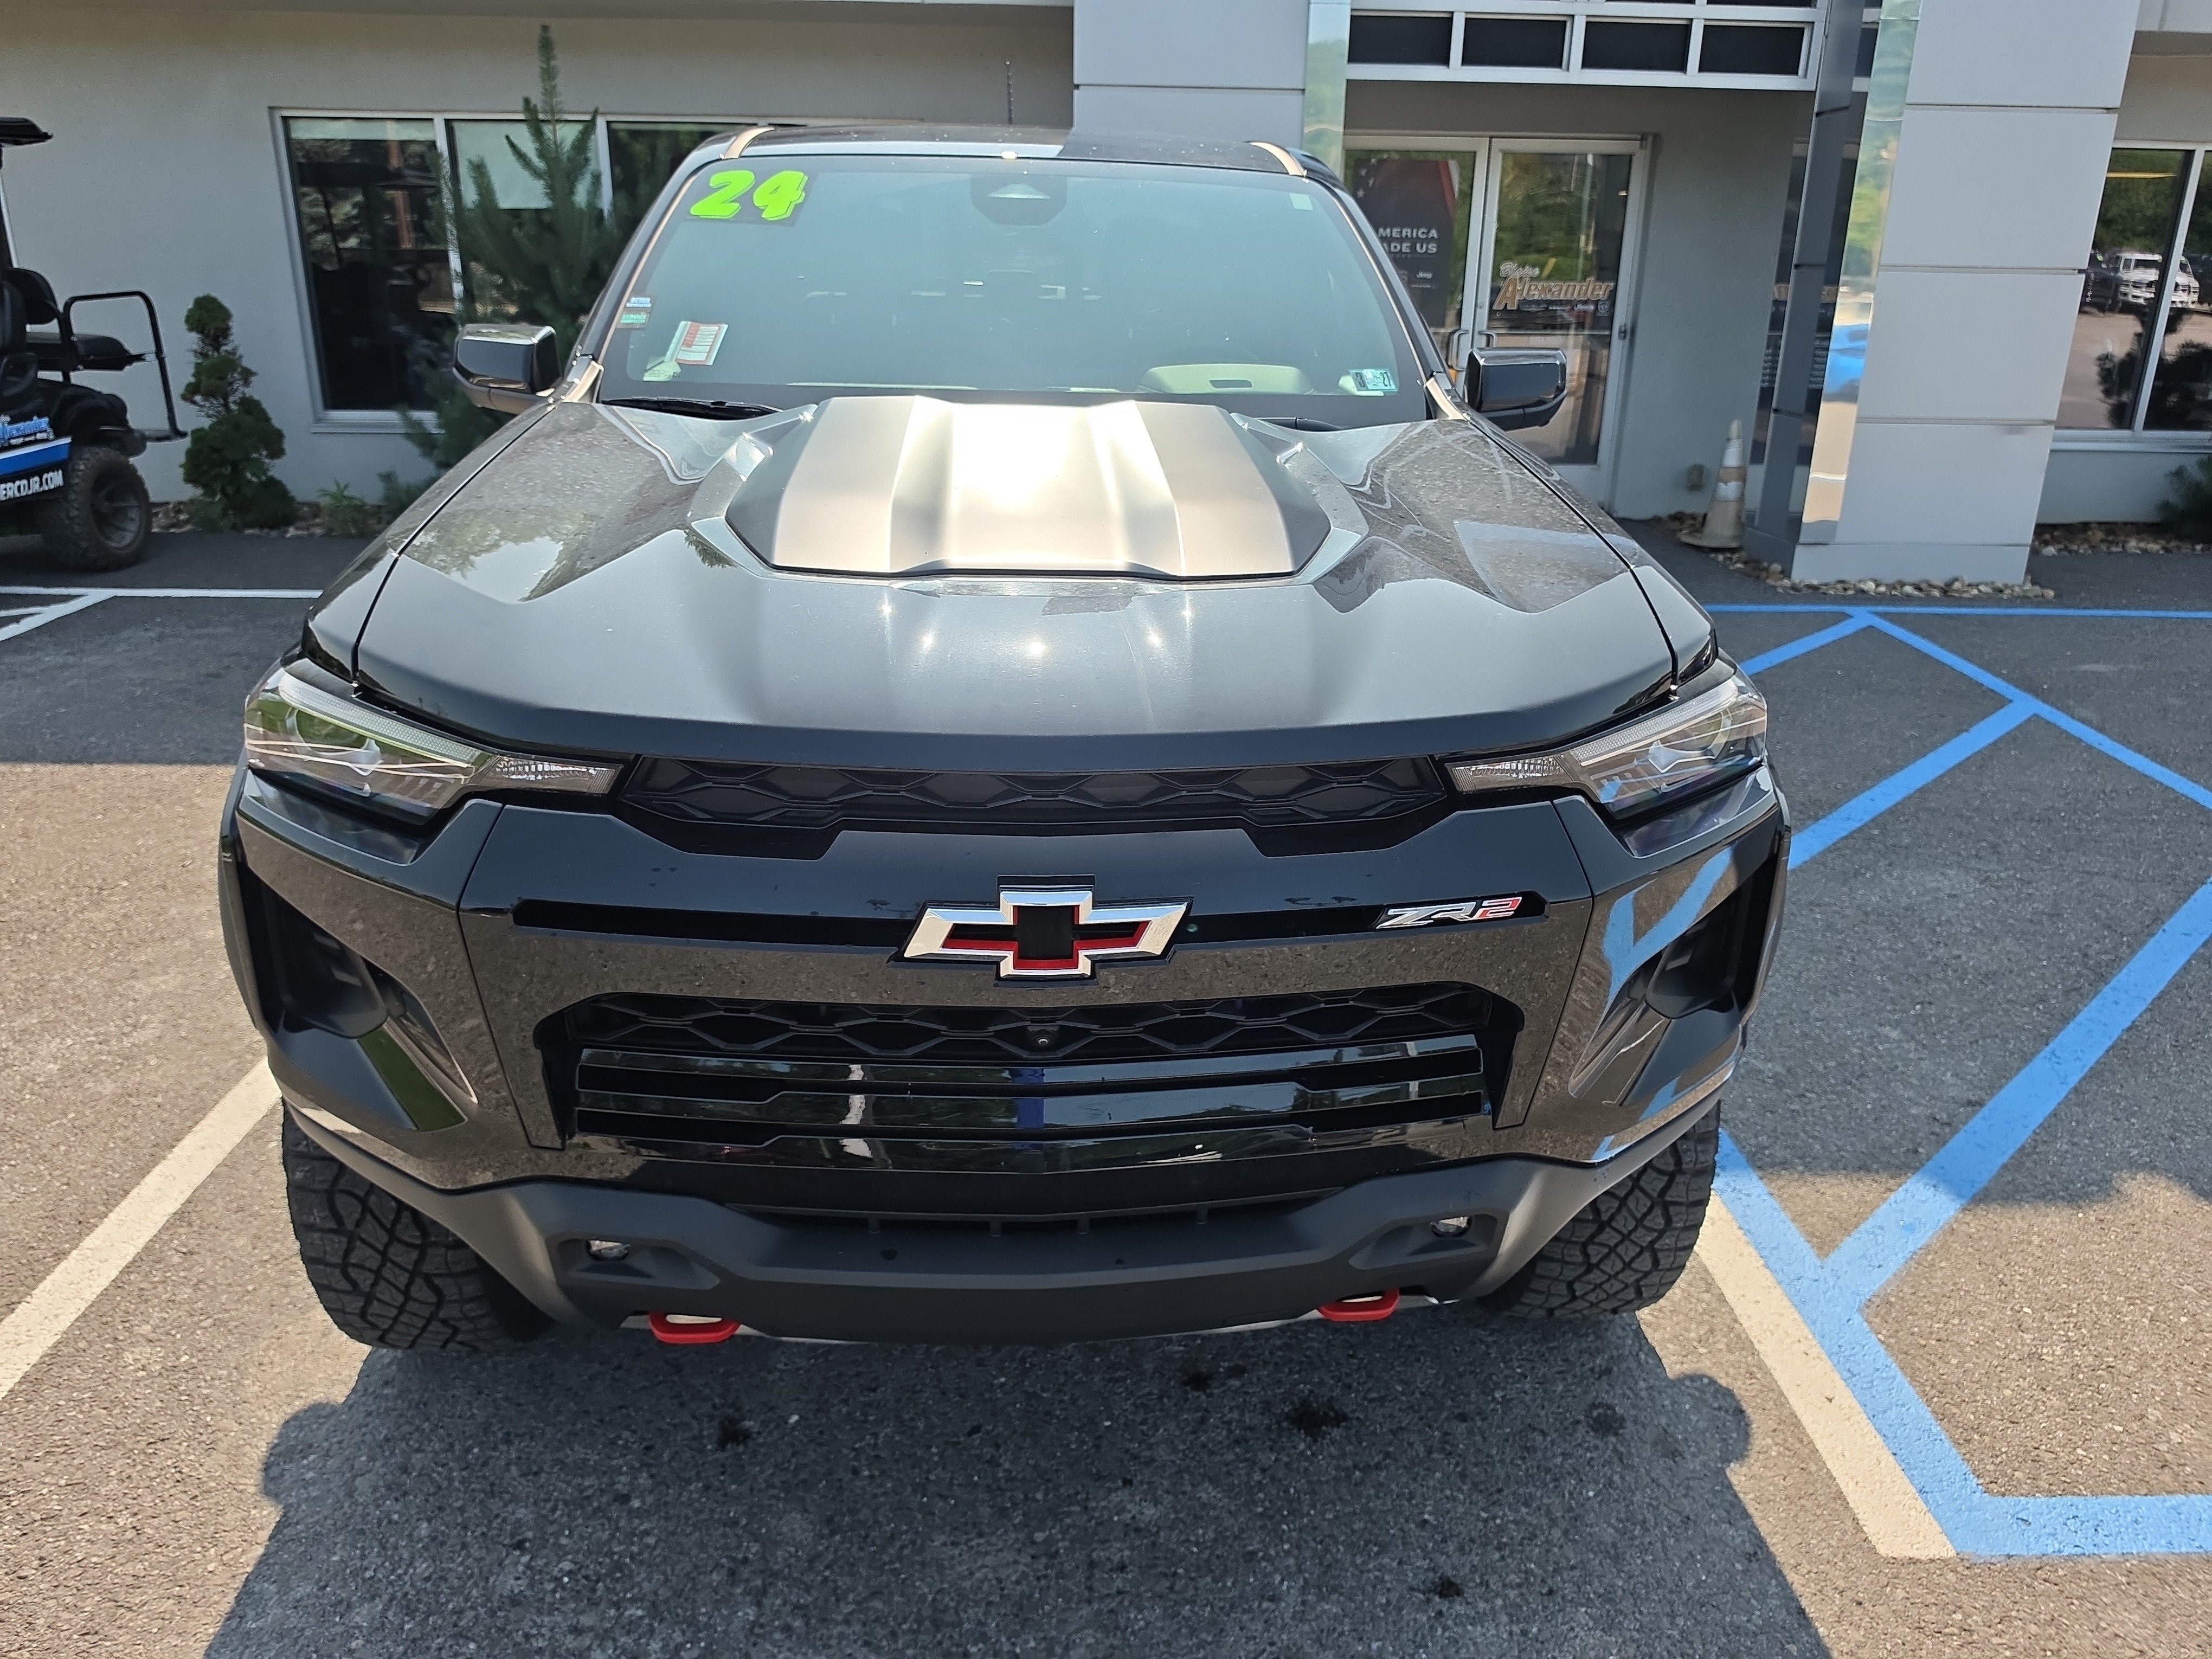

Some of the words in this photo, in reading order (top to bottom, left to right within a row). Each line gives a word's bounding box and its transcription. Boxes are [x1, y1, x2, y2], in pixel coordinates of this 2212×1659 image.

[690, 170, 809, 221] 24
[1416, 242, 1438, 253] US
[1492, 276, 1615, 310] Alexander
[1375, 896, 1522, 929] ZR2
